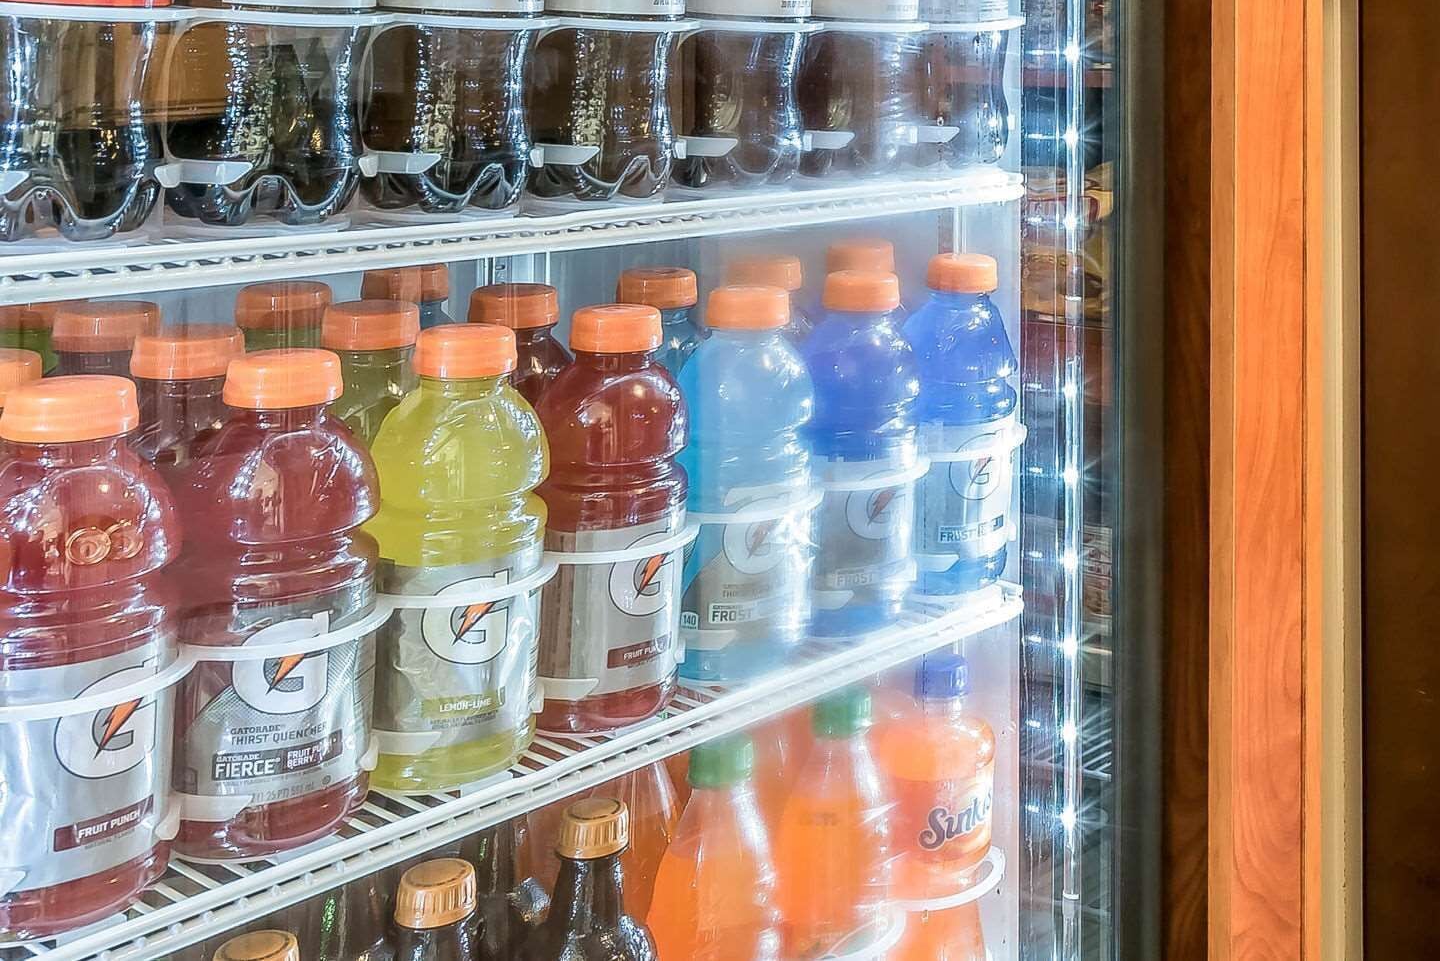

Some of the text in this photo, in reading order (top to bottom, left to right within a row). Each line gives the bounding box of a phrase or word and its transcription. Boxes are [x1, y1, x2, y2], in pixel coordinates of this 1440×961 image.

[683, 614, 697, 626] 140
[623, 649, 642, 661] FRUIT
[439, 697, 492, 713] LEMON-LIME
[230, 725, 282, 736] GATORADE
[231, 733, 269, 746] THIRST
[287, 747, 311, 759] FRUIT
[215, 758, 275, 779] FIERCE
[78, 809, 141, 839] FRUIT PUNCH
